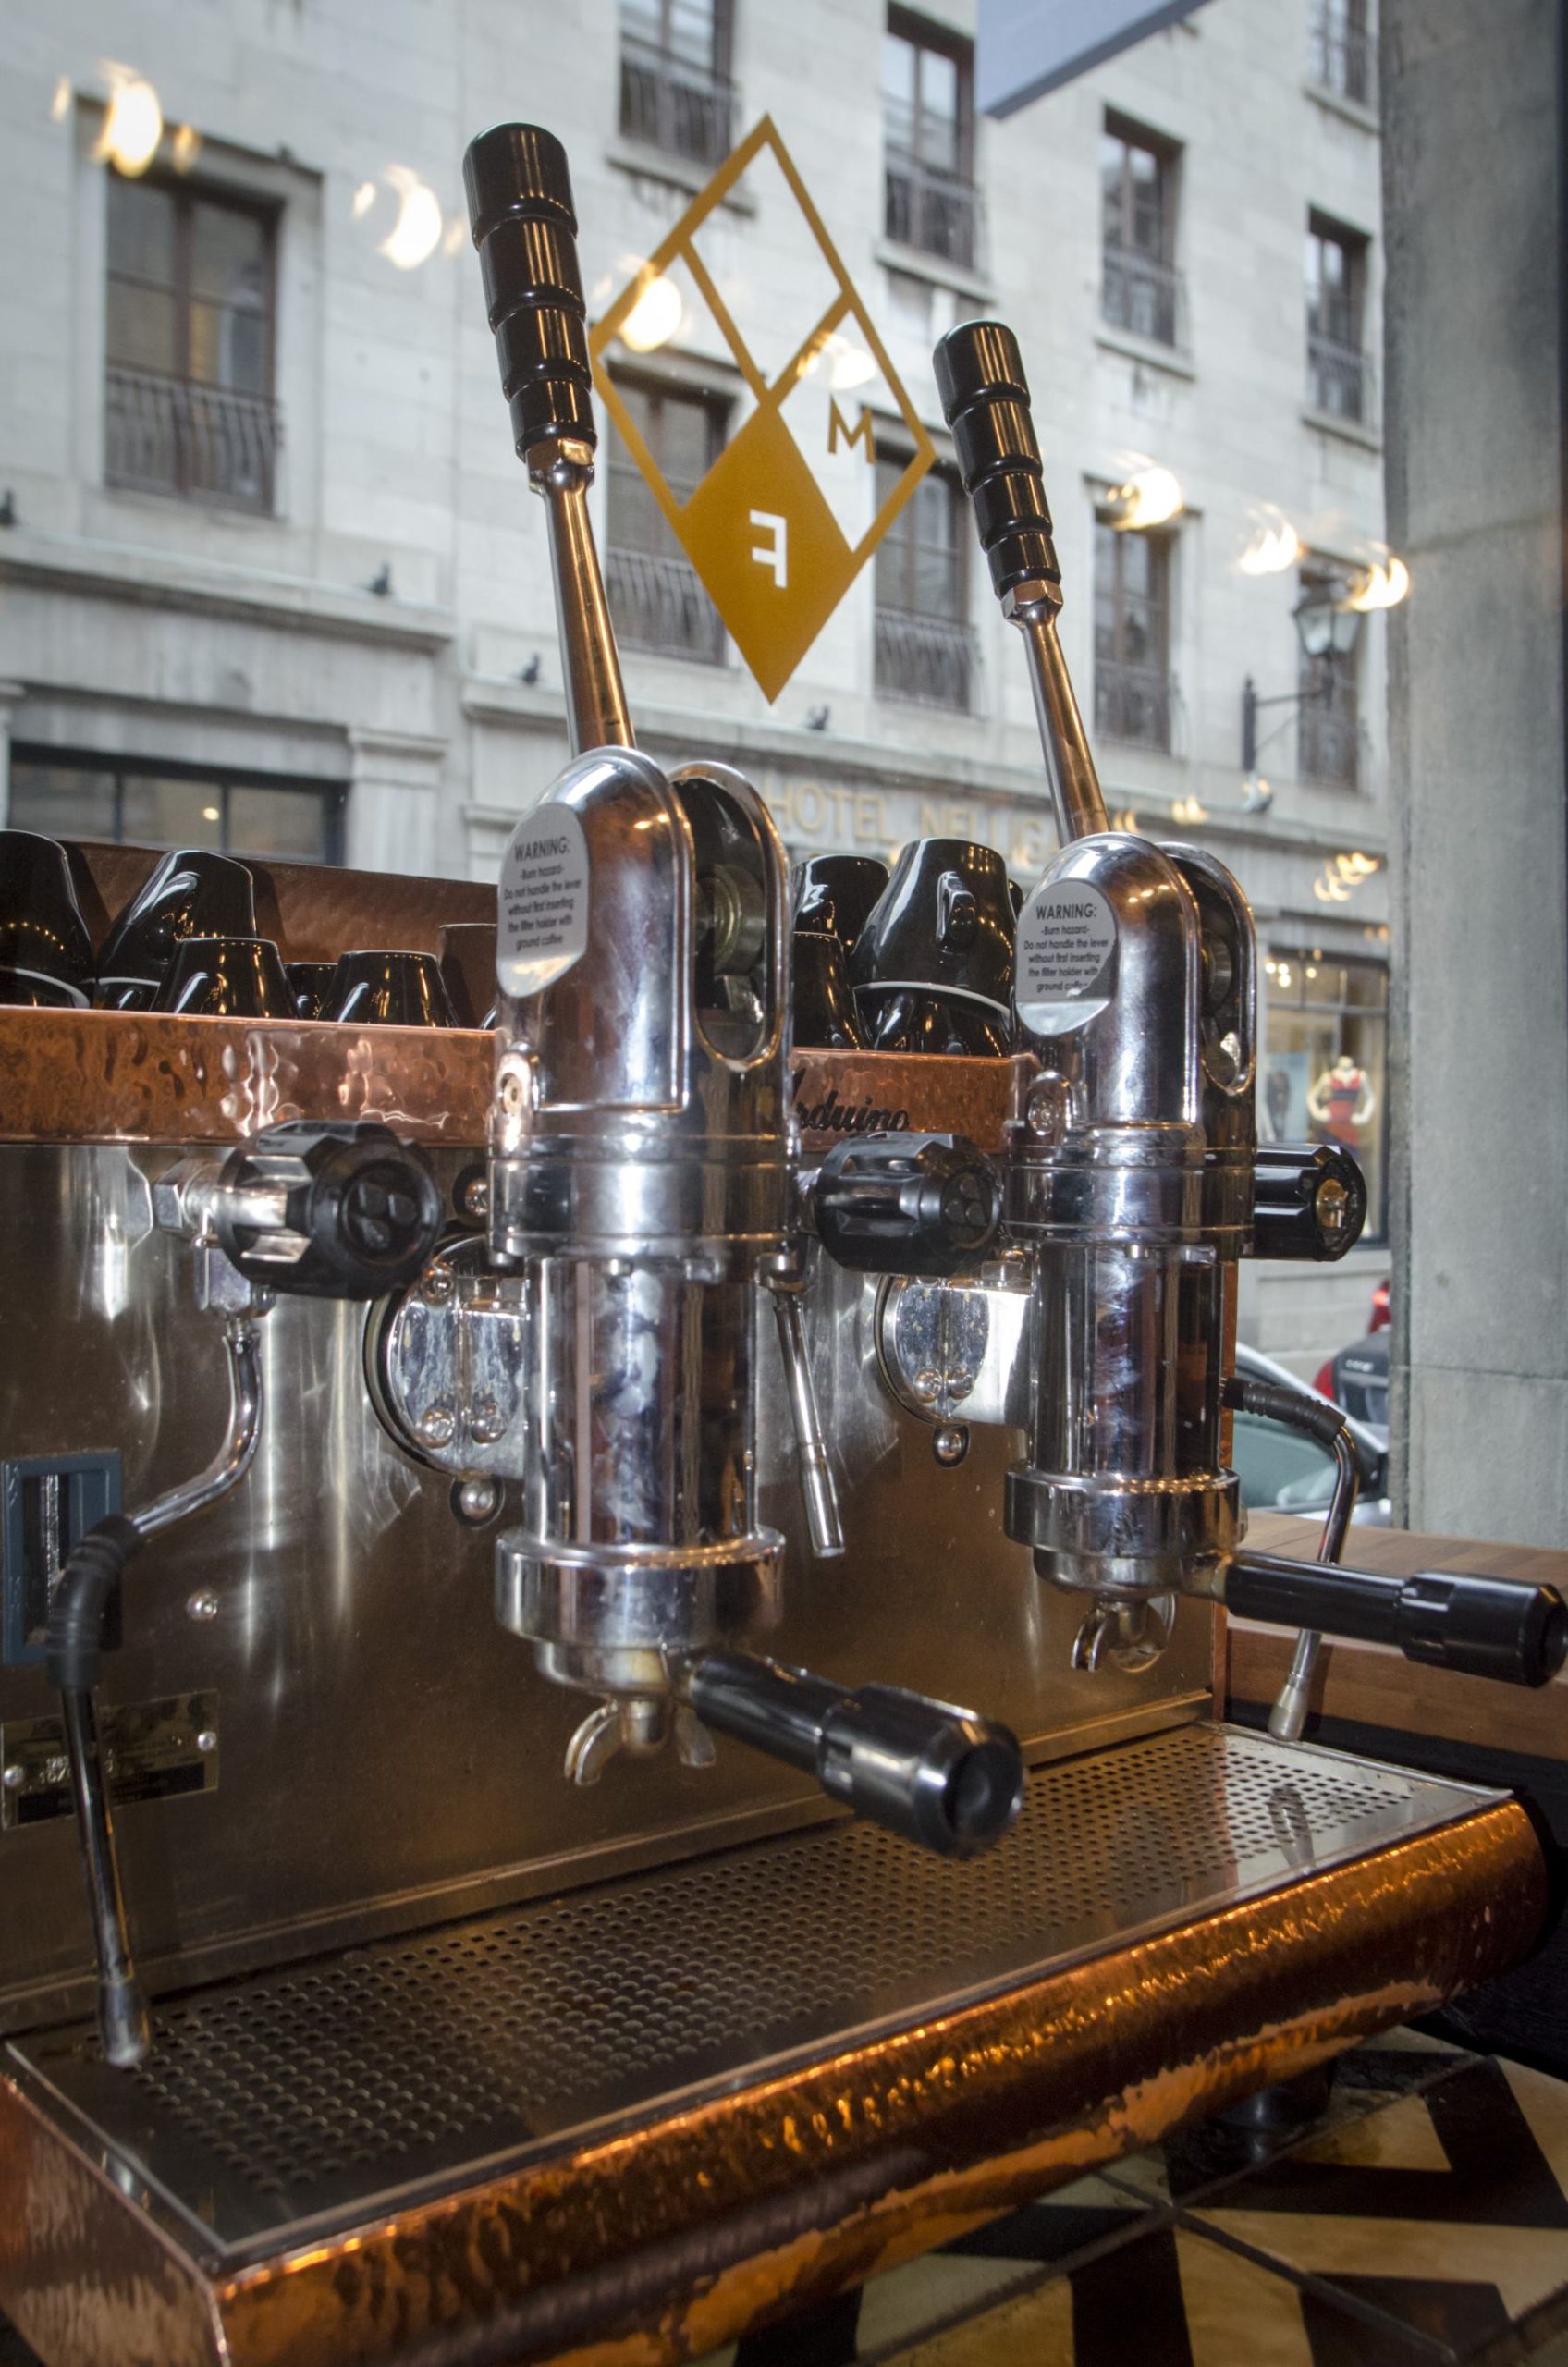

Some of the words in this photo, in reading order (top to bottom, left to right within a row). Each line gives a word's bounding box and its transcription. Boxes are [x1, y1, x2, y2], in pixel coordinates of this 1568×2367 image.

[764, 770, 897, 843] HOTEL
[514, 836, 571, 863] WARNING:
[1035, 902, 1097, 920] WARNING:
[1023, 940, 1034, 950] Do
[1035, 939, 1047, 950] not
[1048, 938, 1074, 949] handle
[1076, 938, 1088, 948] the
[1089, 937, 1109, 948] lever
[1036, 981, 1063, 993] ground
[794, 1067, 910, 1132] rduino
